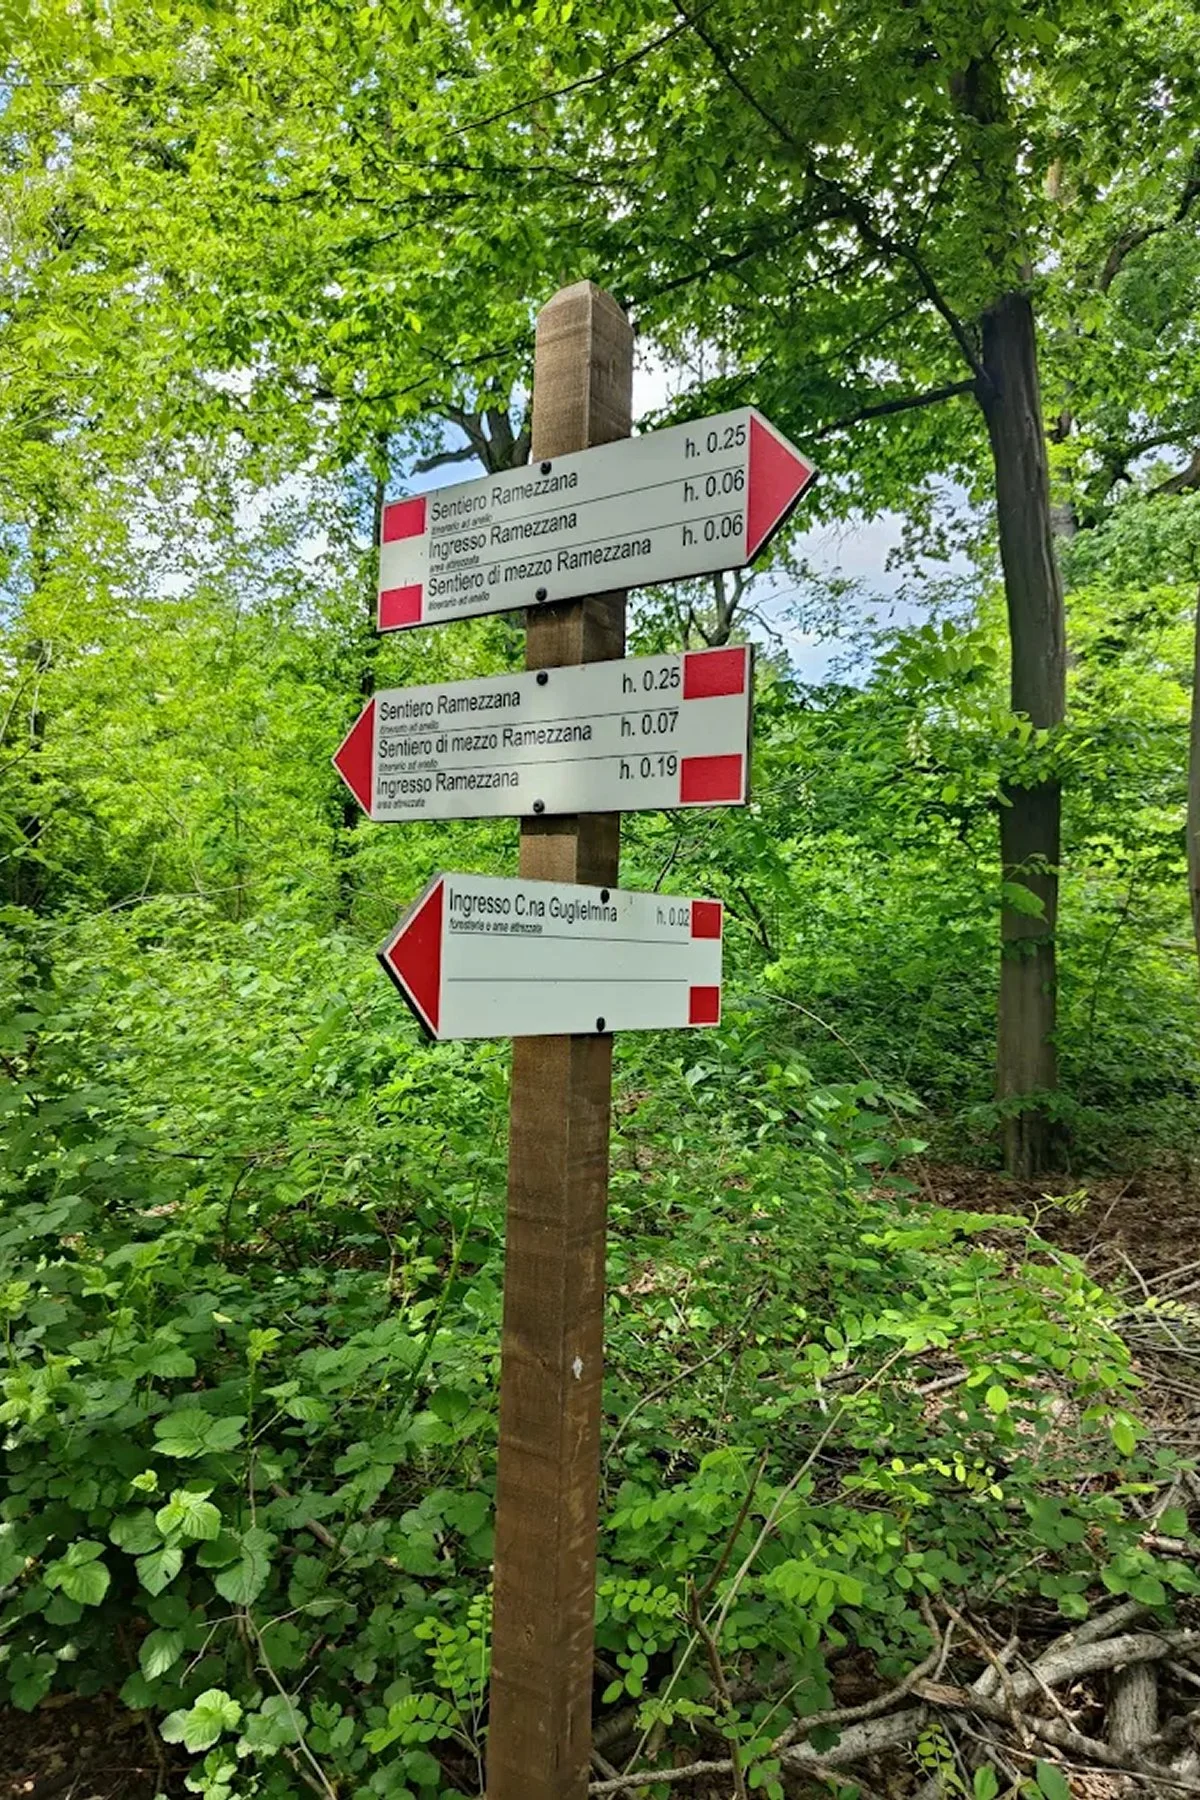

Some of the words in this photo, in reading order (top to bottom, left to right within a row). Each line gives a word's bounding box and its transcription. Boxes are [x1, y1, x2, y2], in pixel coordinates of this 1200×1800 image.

[431, 496, 487, 521] Sentiero
[492, 472, 578, 507] Ramezzana
[685, 438, 700, 458] h.
[707, 424, 746, 453] 0.25
[429, 534, 486, 560] Ingresso
[491, 512, 577, 546] Ramezzana
[684, 482, 699, 502] h.
[706, 469, 745, 498] 0.06
[428, 573, 484, 596] Sentiero
[488, 564, 500, 585] di
[504, 559, 552, 582] mezzo
[557, 538, 651, 571] Ramezzana
[682, 526, 698, 546] h.
[704, 514, 743, 541] 0.06
[379, 700, 433, 721] Sentiero
[437, 690, 520, 714] Ramezzana
[622, 673, 637, 693] h.
[643, 667, 680, 691] 0.25
[378, 738, 432, 758] Sentiero
[436, 733, 448, 753] di
[452, 734, 498, 751] mezzo
[503, 724, 592, 748] Ramezzana
[621, 716, 635, 737] h.
[641, 711, 679, 735] 0.07
[377, 777, 432, 799] Ingresso
[436, 771, 519, 792] Ramezzana
[619, 760, 634, 780] h.
[640, 755, 677, 778] 0.19
[450, 888, 510, 918] Ingresso
[515, 894, 545, 917] C.na
[550, 897, 617, 925] Guglielmina
[656, 906, 666, 925] h.
[669, 907, 689, 926] 0.02
